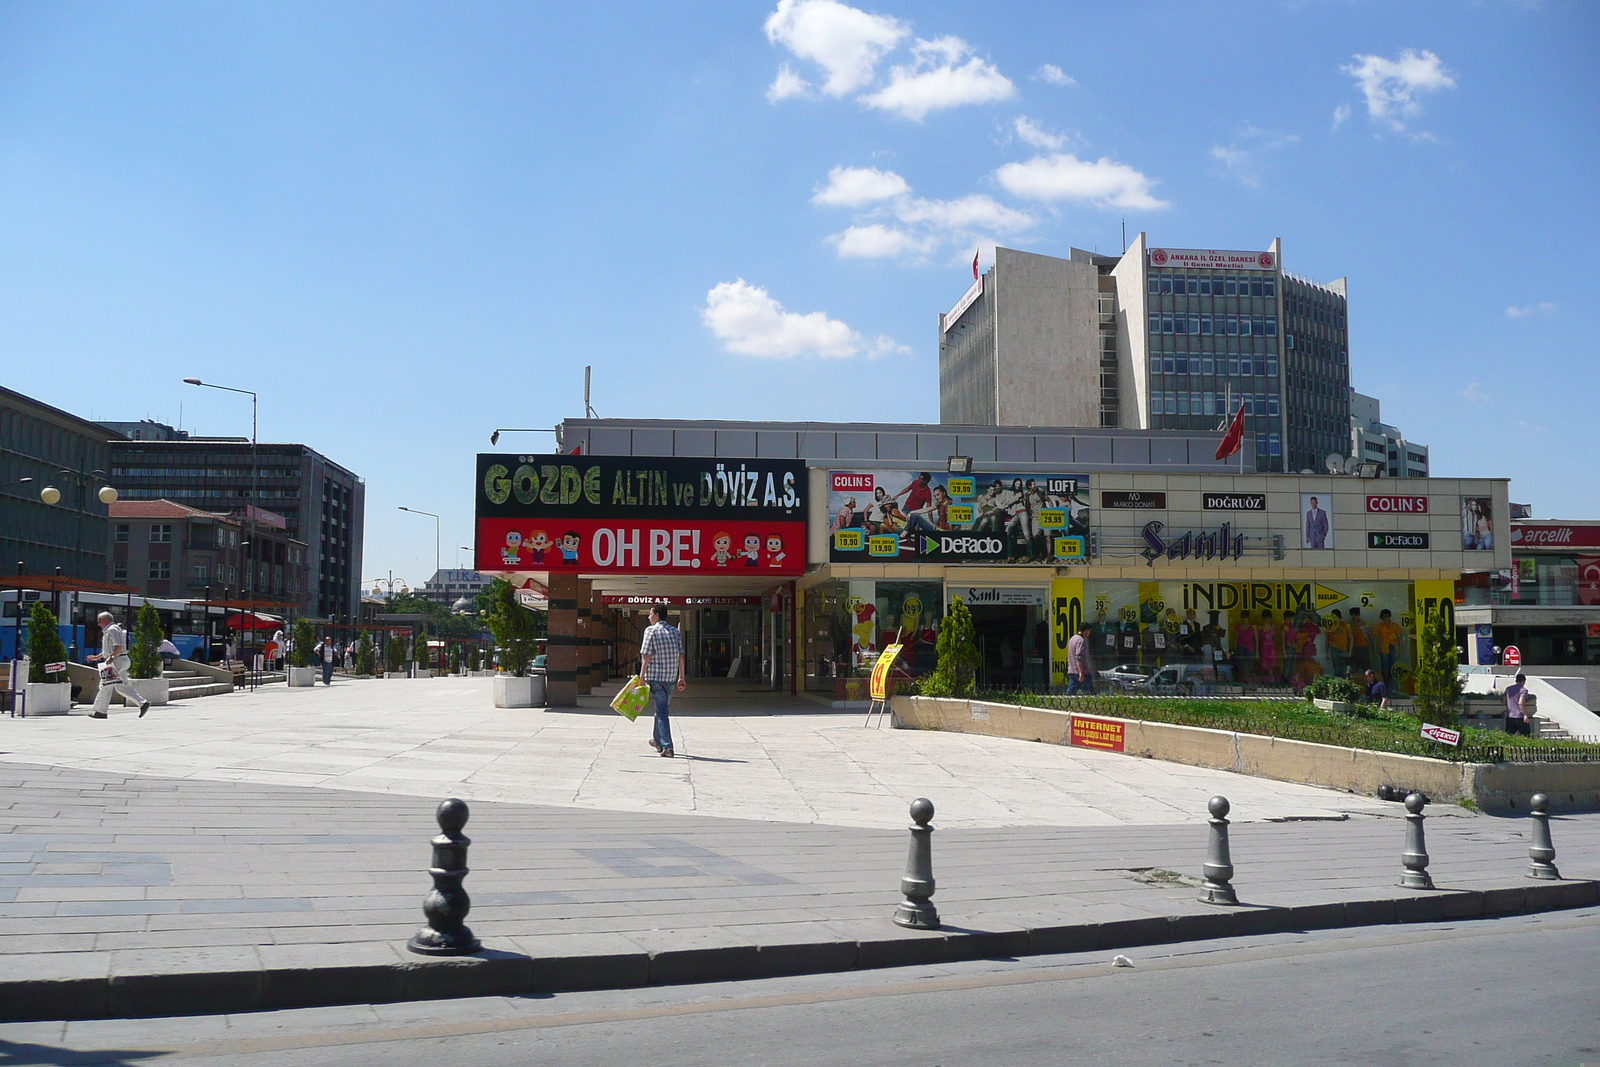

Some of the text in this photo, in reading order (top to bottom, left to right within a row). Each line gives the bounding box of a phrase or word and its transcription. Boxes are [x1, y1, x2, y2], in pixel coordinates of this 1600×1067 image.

[484, 455, 800, 514] GÖZDE ALTIN ve DÖVİZ A.Ş.
[1049, 479, 1076, 492] LOFT
[1207, 496, 1261, 509] DOĞRUÖZ
[1384, 534, 1423, 546] DeFacto
[1524, 527, 1573, 545] arçelik
[591, 527, 701, 569] OH BE!
[940, 536, 1003, 554] DeFacto
[627, 595, 653, 604] DÖVİZ
[654, 597, 672, 605] A.Ş.
[968, 587, 1001, 604] Şanlı
[1095, 600, 1104, 611] 39
